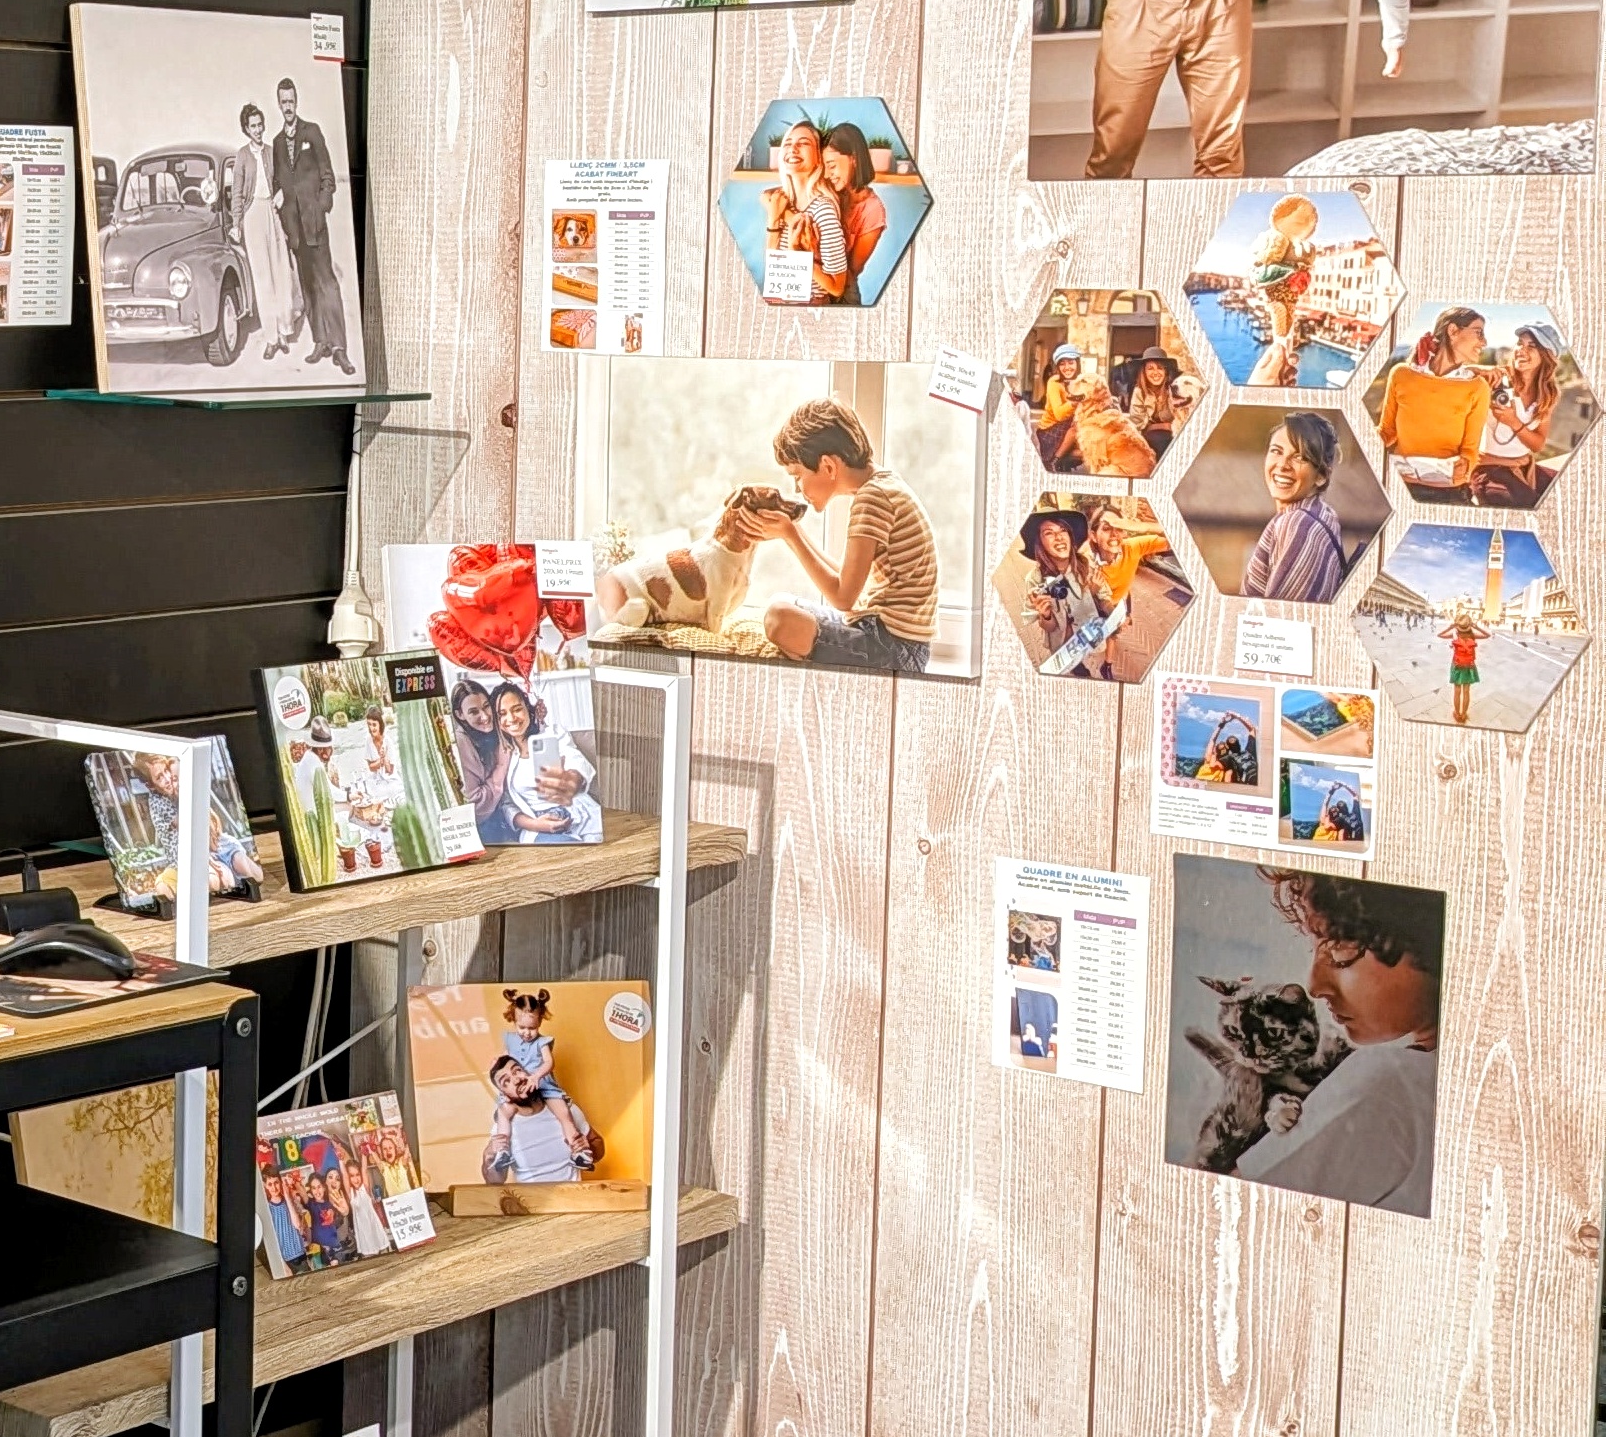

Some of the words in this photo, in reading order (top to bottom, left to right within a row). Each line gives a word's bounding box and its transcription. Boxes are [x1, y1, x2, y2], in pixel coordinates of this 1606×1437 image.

[395, 665, 425, 678] Disponible
[427, 666, 434, 674] en
[395, 675, 436, 694] EXPRESS
[1023, 866, 1062, 879] QUADRE
[1065, 872, 1078, 881] EN
[1081, 874, 1123, 887] ALUMINI
